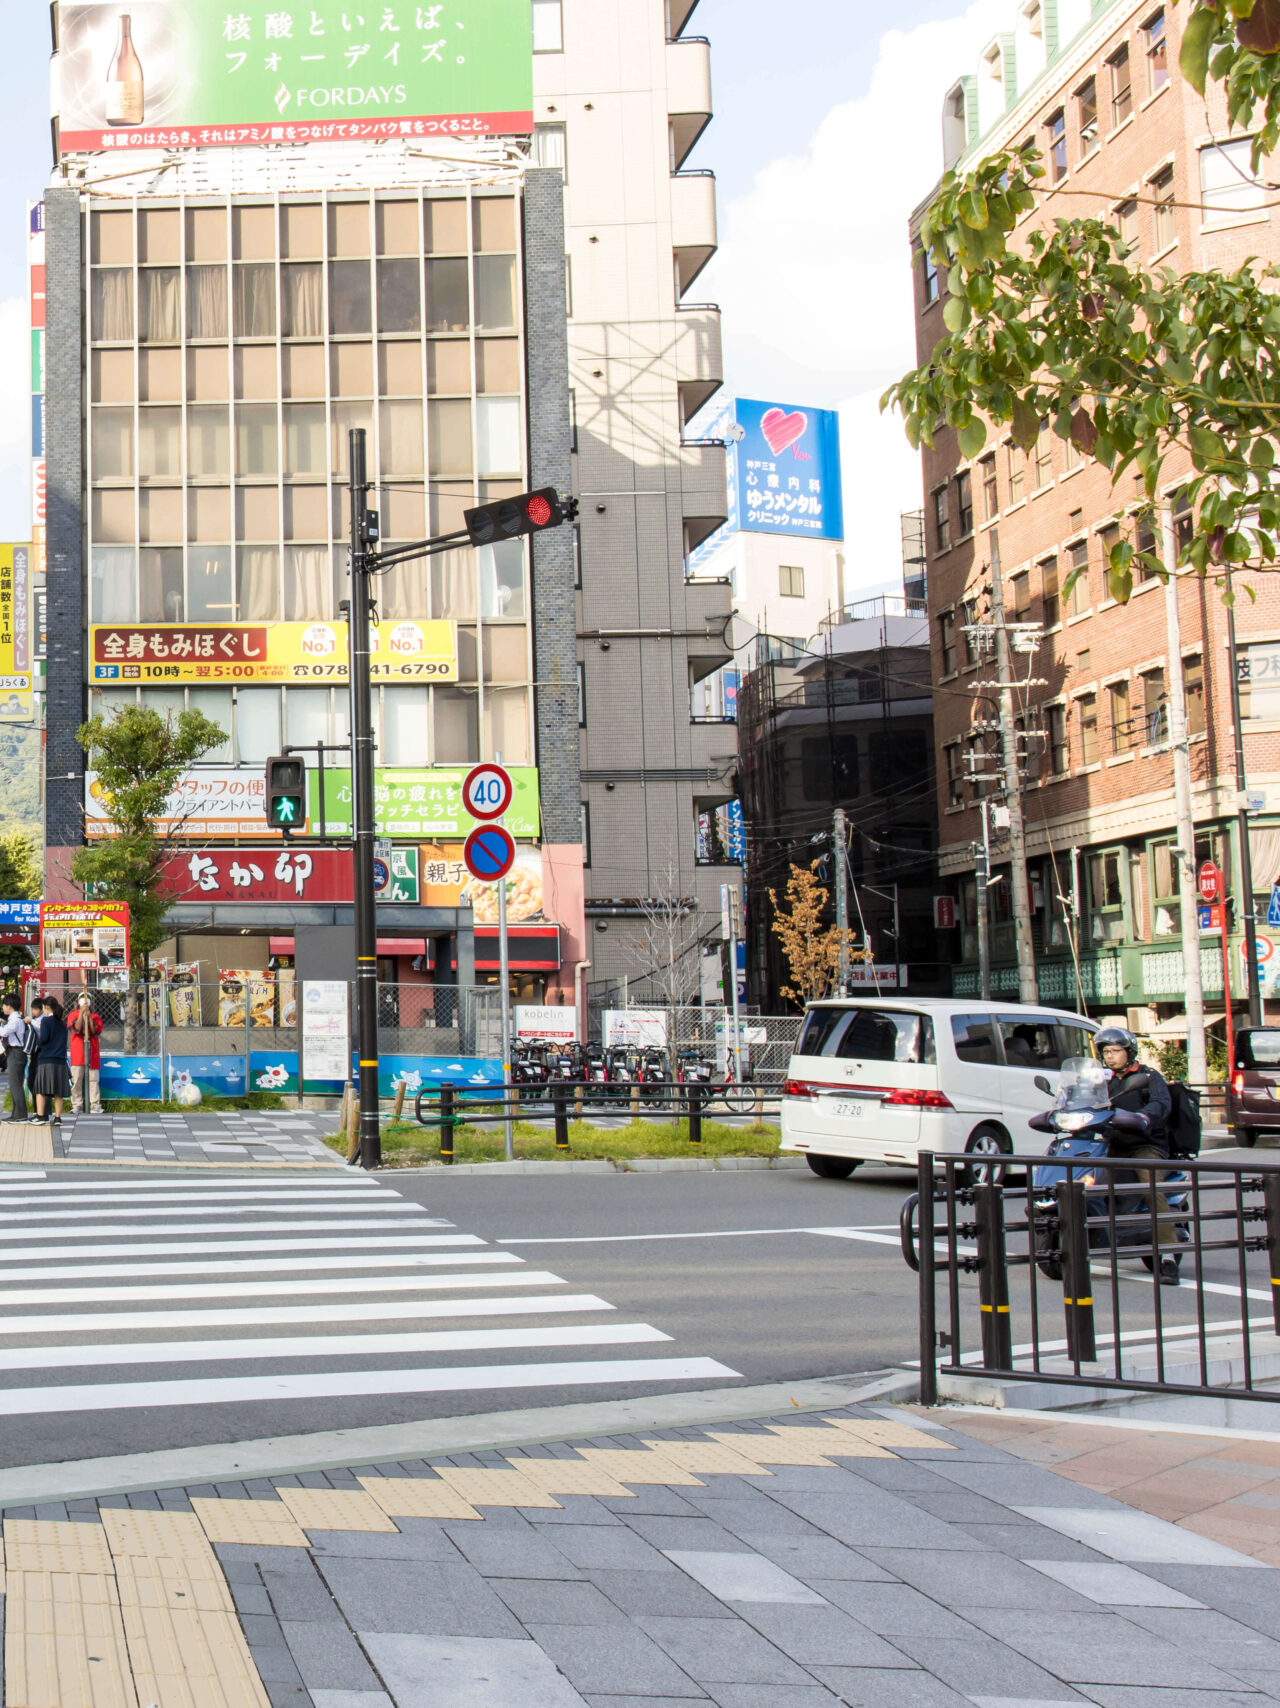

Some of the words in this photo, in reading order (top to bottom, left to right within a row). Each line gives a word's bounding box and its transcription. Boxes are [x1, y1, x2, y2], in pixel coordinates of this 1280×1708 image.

[222, 4, 468, 40] 核酸といえば、
[226, 39, 468, 74] フォーデイズ。
[297, 85, 407, 107] FORDAYS
[101, 118, 490, 147] 核酸のはたらき、それはアミノ酸をつなげてタンパク質をつくること。
[745, 472, 822, 494] 心療内科
[746, 489, 822, 515] ゆうメンタル
[747, 510, 790, 526] クリニック
[14, 551, 27, 667] 全身もみほぐし
[102, 632, 261, 659] 全身もみほぐし
[302, 640, 336, 653] No.1
[390, 638, 424, 651] No.1
[99, 667, 116, 678] 3F
[313, 663, 450, 677] 07841-6790
[473, 779, 501, 805] 40
[375, 803, 463, 818] タッチセラピ
[187, 852, 313, 898] なか卯
[426, 861, 475, 883] 親子
[14, 915, 24, 923] for
[524, 1008, 564, 1019] kobelin
[836, 1104, 862, 1116] 27-20
